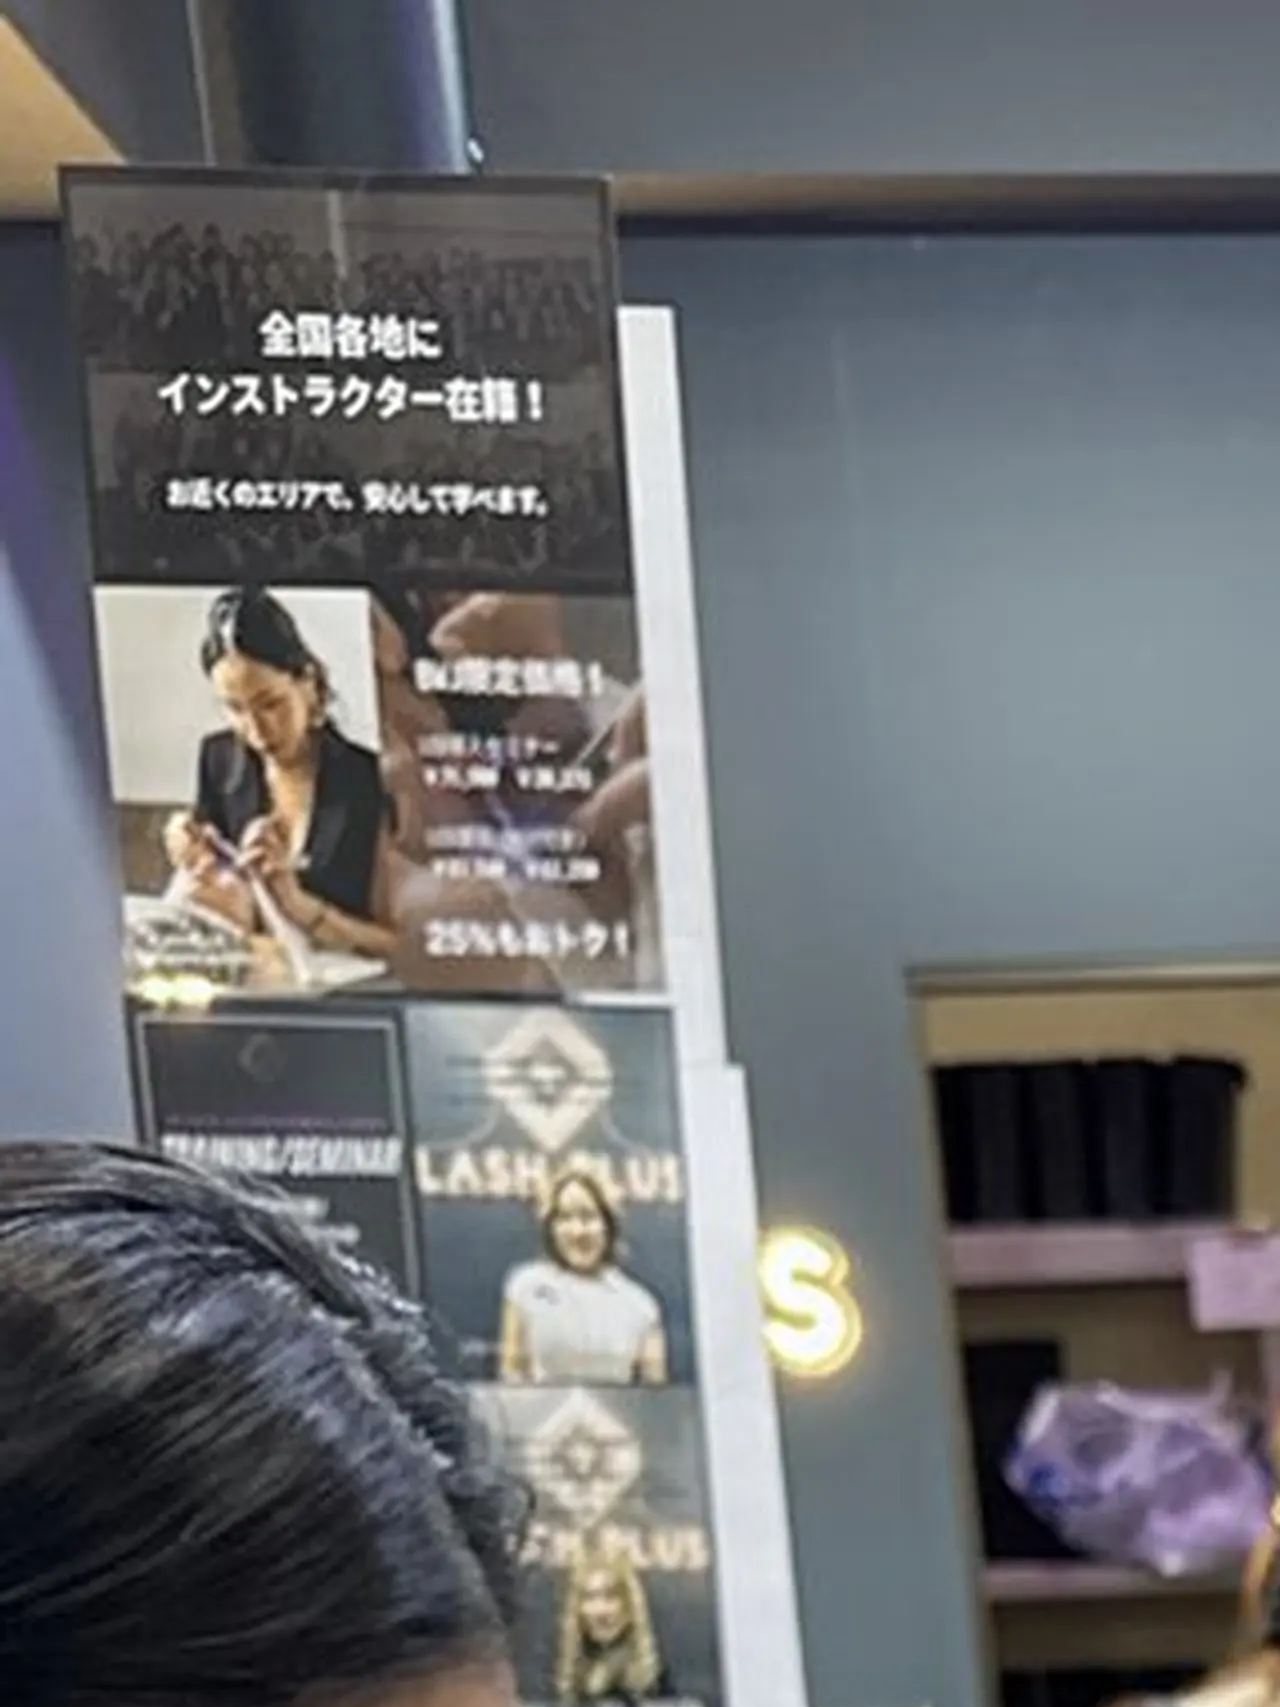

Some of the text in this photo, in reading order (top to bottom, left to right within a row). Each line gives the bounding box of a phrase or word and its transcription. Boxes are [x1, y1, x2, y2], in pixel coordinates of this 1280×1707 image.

[258, 310, 442, 360] 全国各地に
[414, 1147, 546, 1200] LASH
[759, 1228, 860, 1377] S
